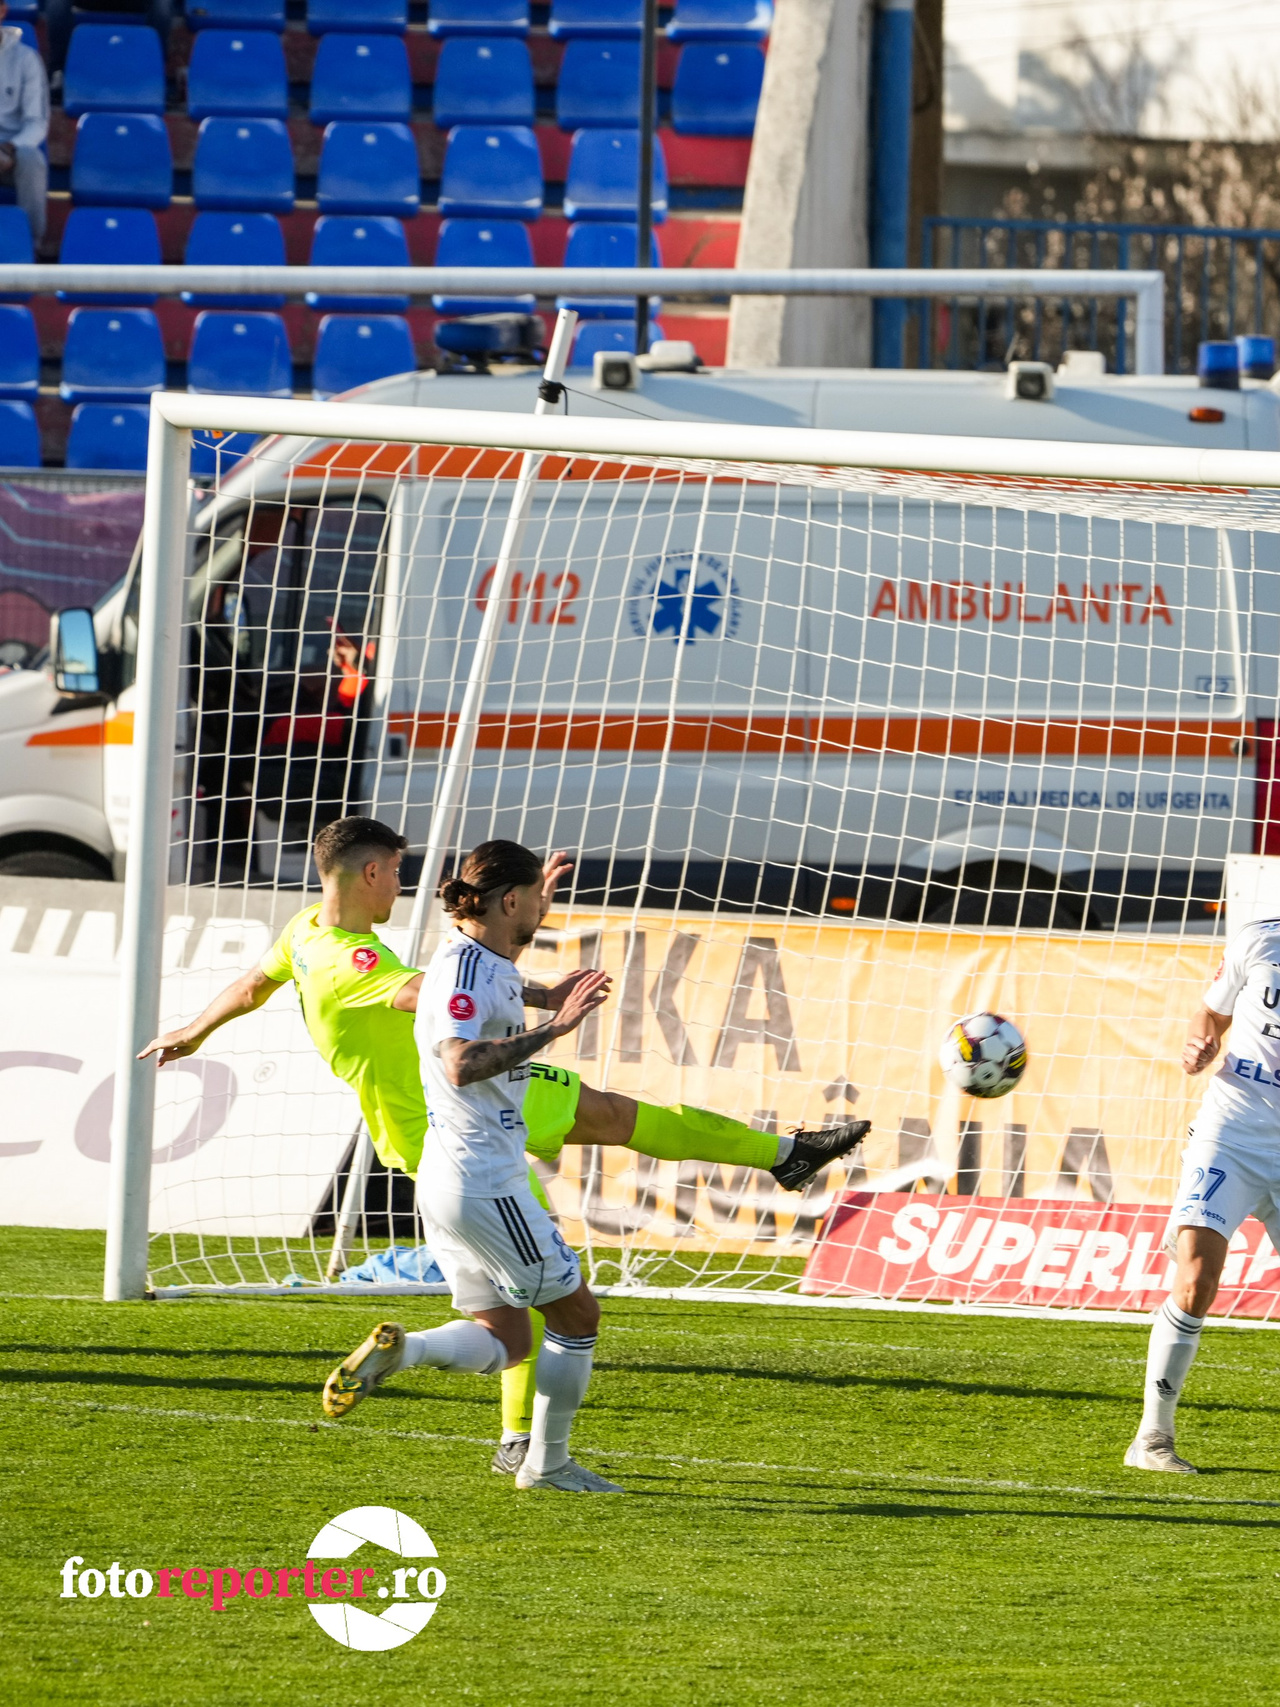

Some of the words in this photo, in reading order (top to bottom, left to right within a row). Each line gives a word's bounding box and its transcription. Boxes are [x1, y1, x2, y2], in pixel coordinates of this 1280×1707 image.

[508, 571, 580, 624] 112
[871, 580, 1173, 626] AMBULANTA
[954, 790, 1027, 807] ECHIPAJ
[1035, 791, 1109, 808] MEDICAL
[1118, 792, 1141, 808] DE
[1147, 792, 1230, 810] URGENTA
[1186, 1167, 1226, 1202] 27
[1200, 1207, 1227, 1225] Vestra
